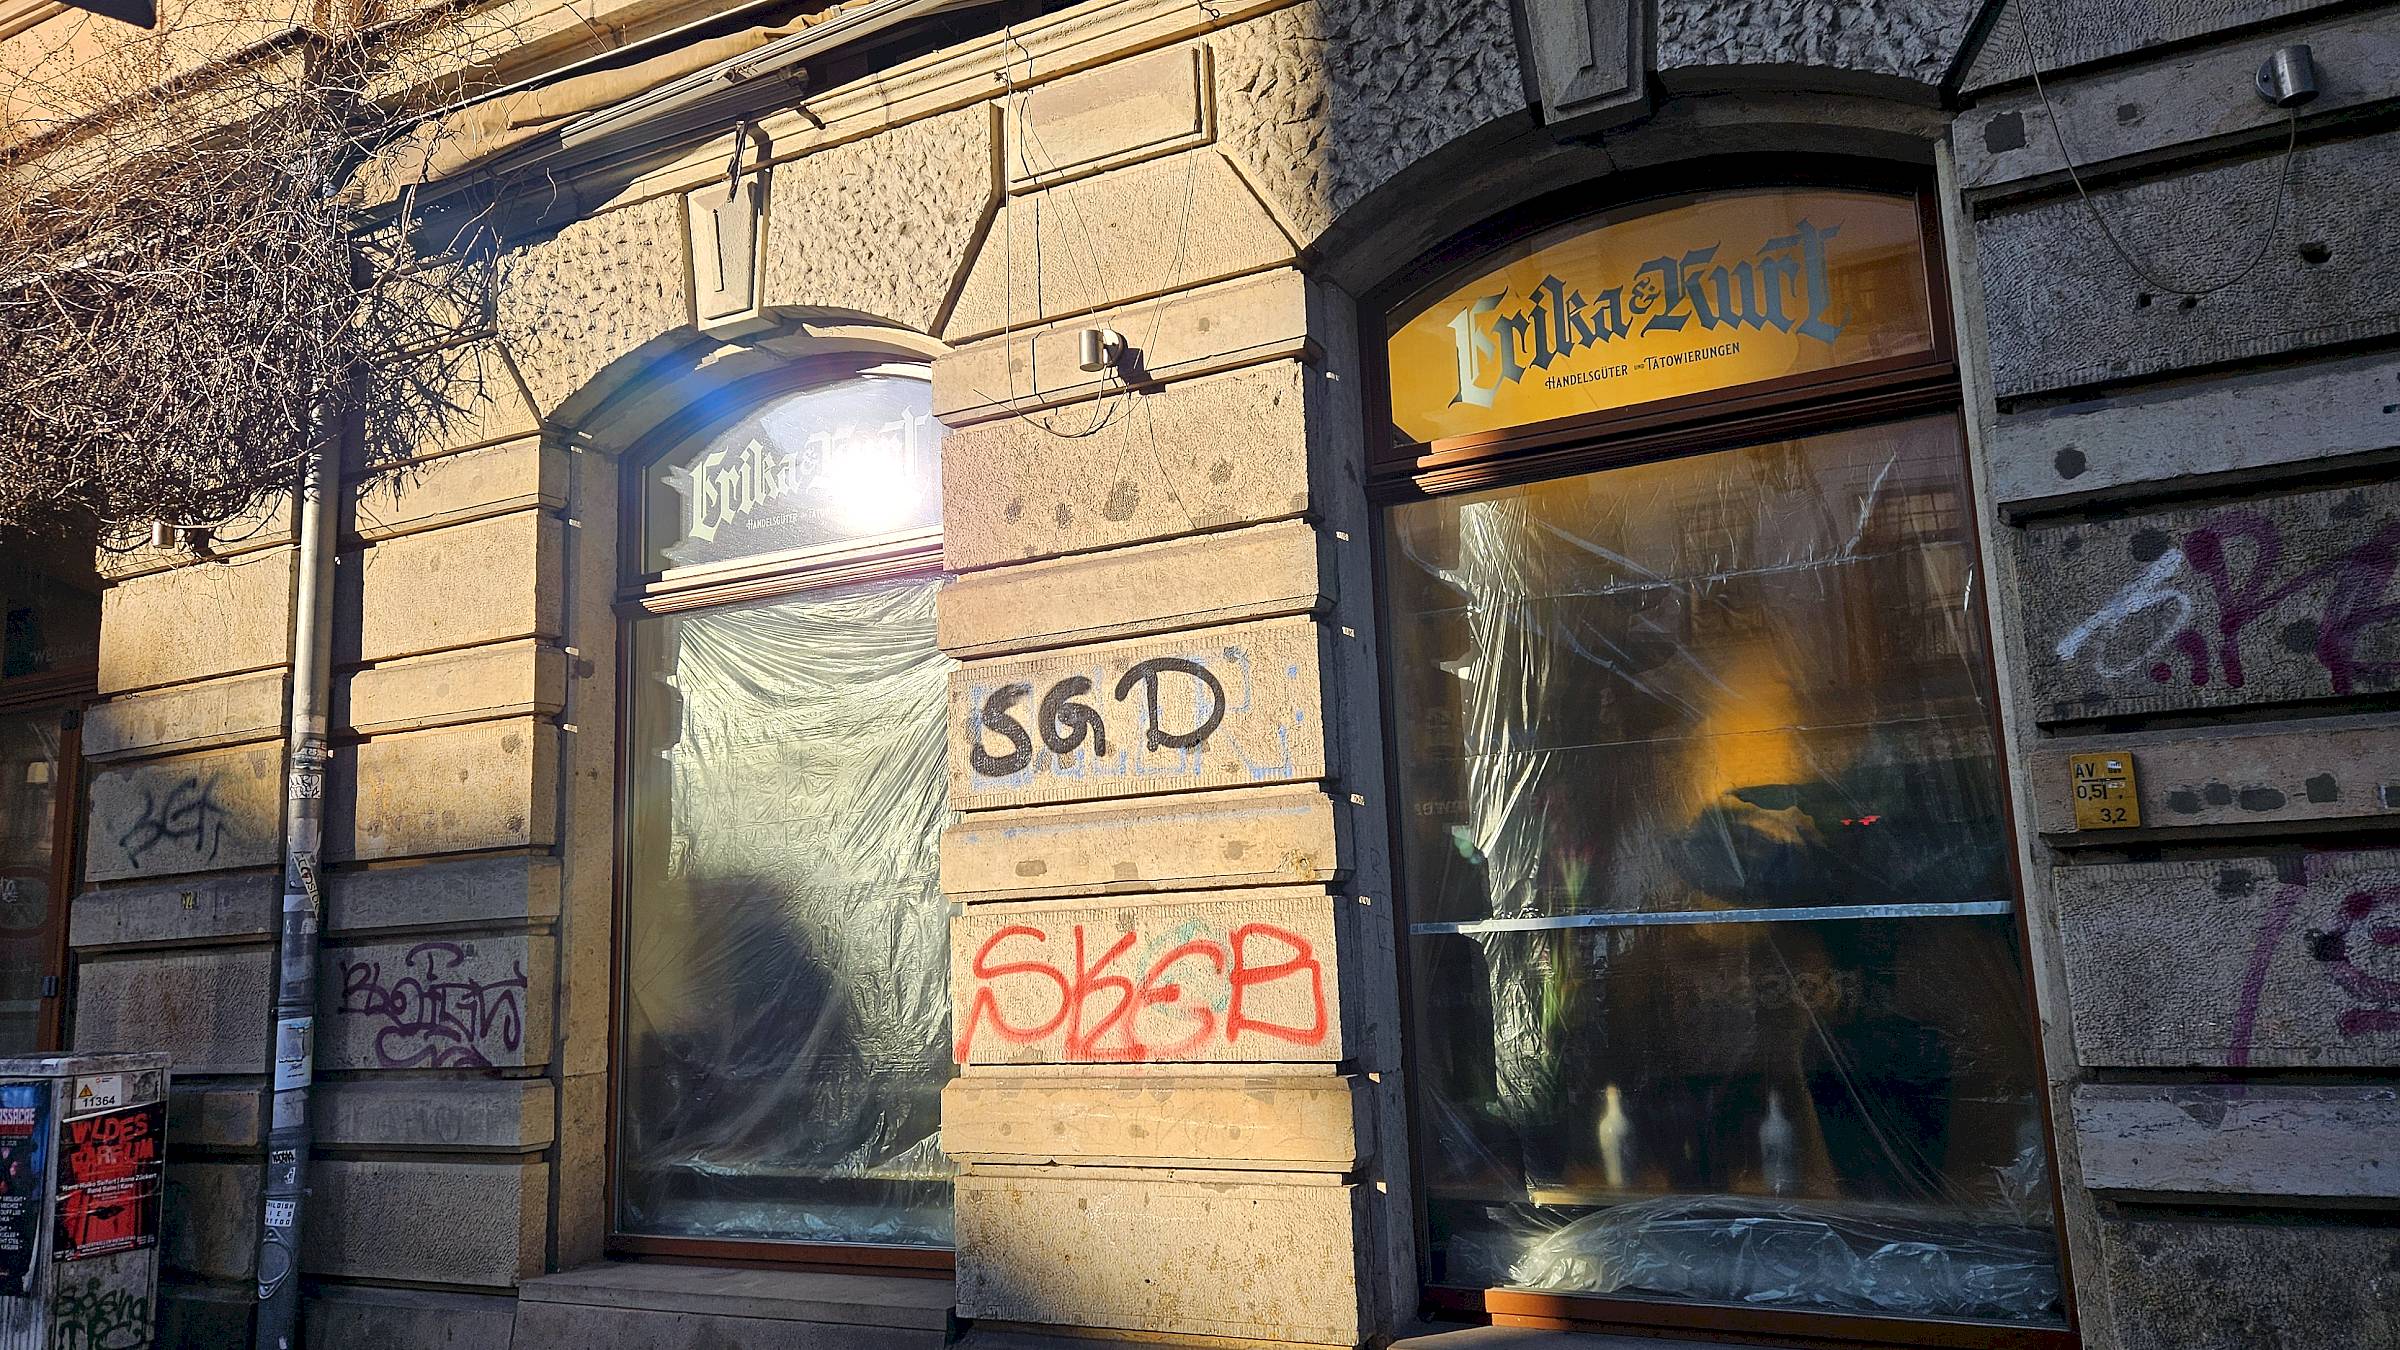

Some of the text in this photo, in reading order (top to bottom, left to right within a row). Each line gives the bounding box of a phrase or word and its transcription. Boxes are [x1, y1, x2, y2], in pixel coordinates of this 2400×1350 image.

[2076, 762, 2095, 778] AV
[2100, 807, 2127, 824] 3,2
[83, 1095, 116, 1108] 11364
[0, 1107, 36, 1125] ASSACRE
